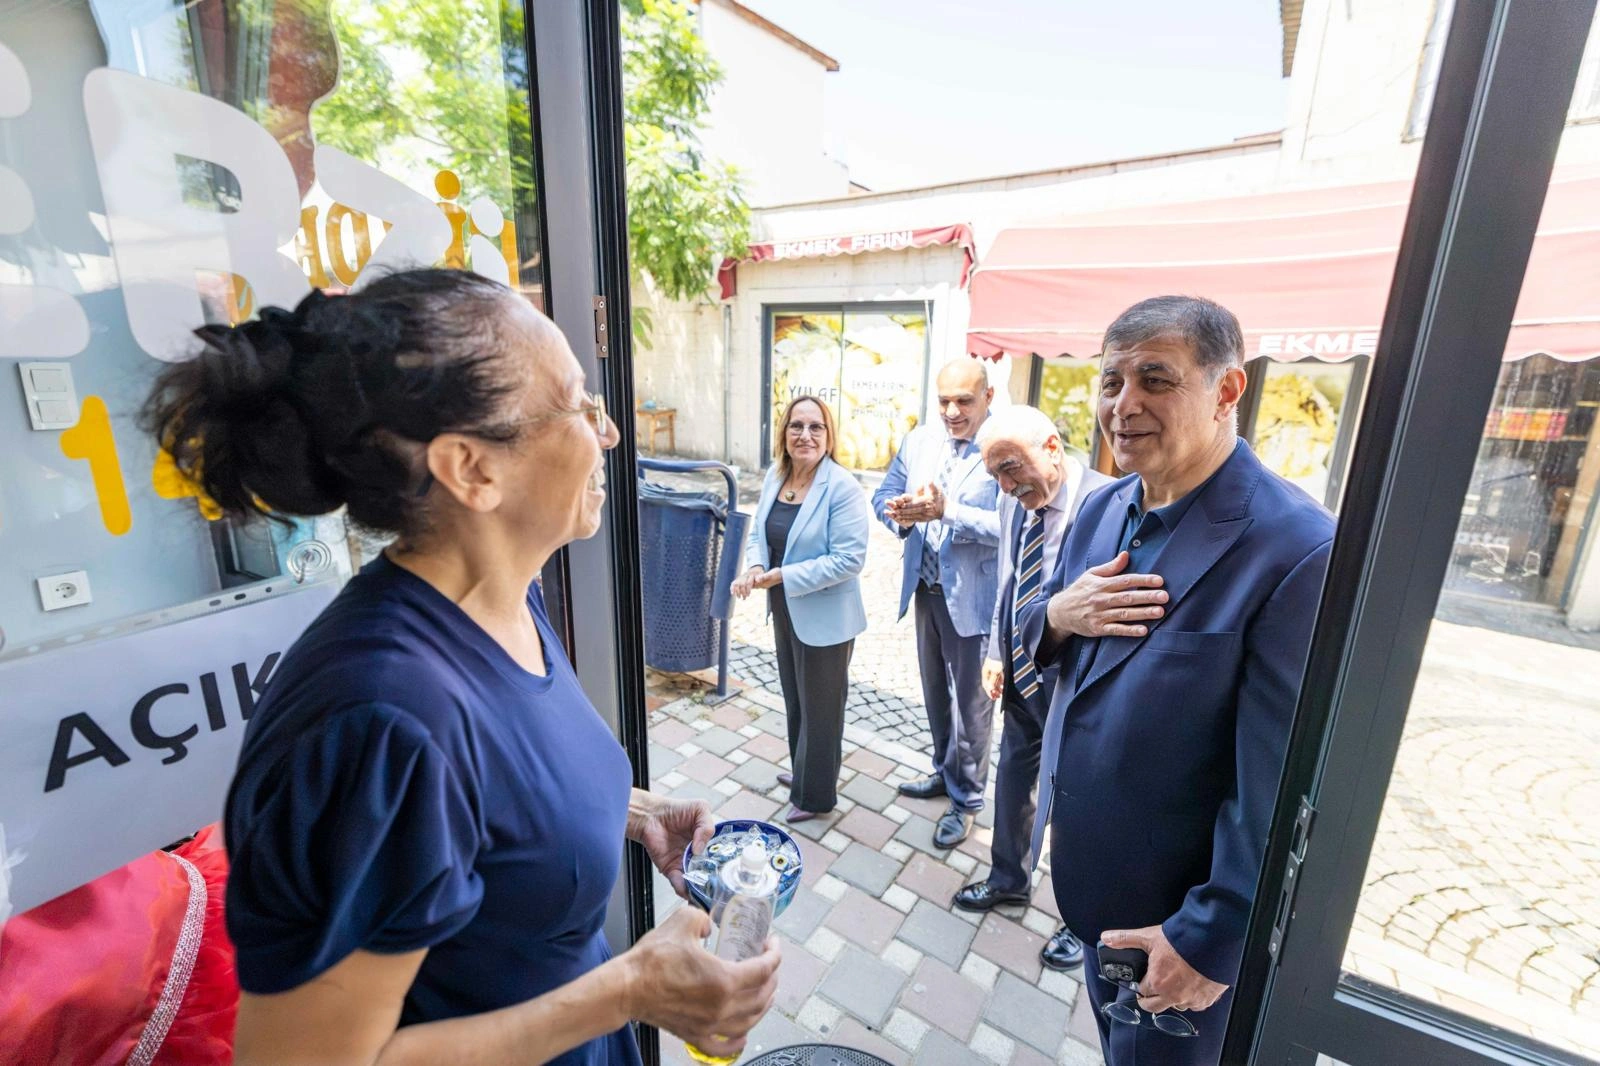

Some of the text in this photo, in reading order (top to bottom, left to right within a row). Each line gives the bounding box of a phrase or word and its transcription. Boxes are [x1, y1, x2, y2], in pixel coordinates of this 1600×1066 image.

[773, 238, 841, 258] EKMEK
[1259, 332, 1377, 353] EKME
[44, 651, 282, 793] AÇIK
